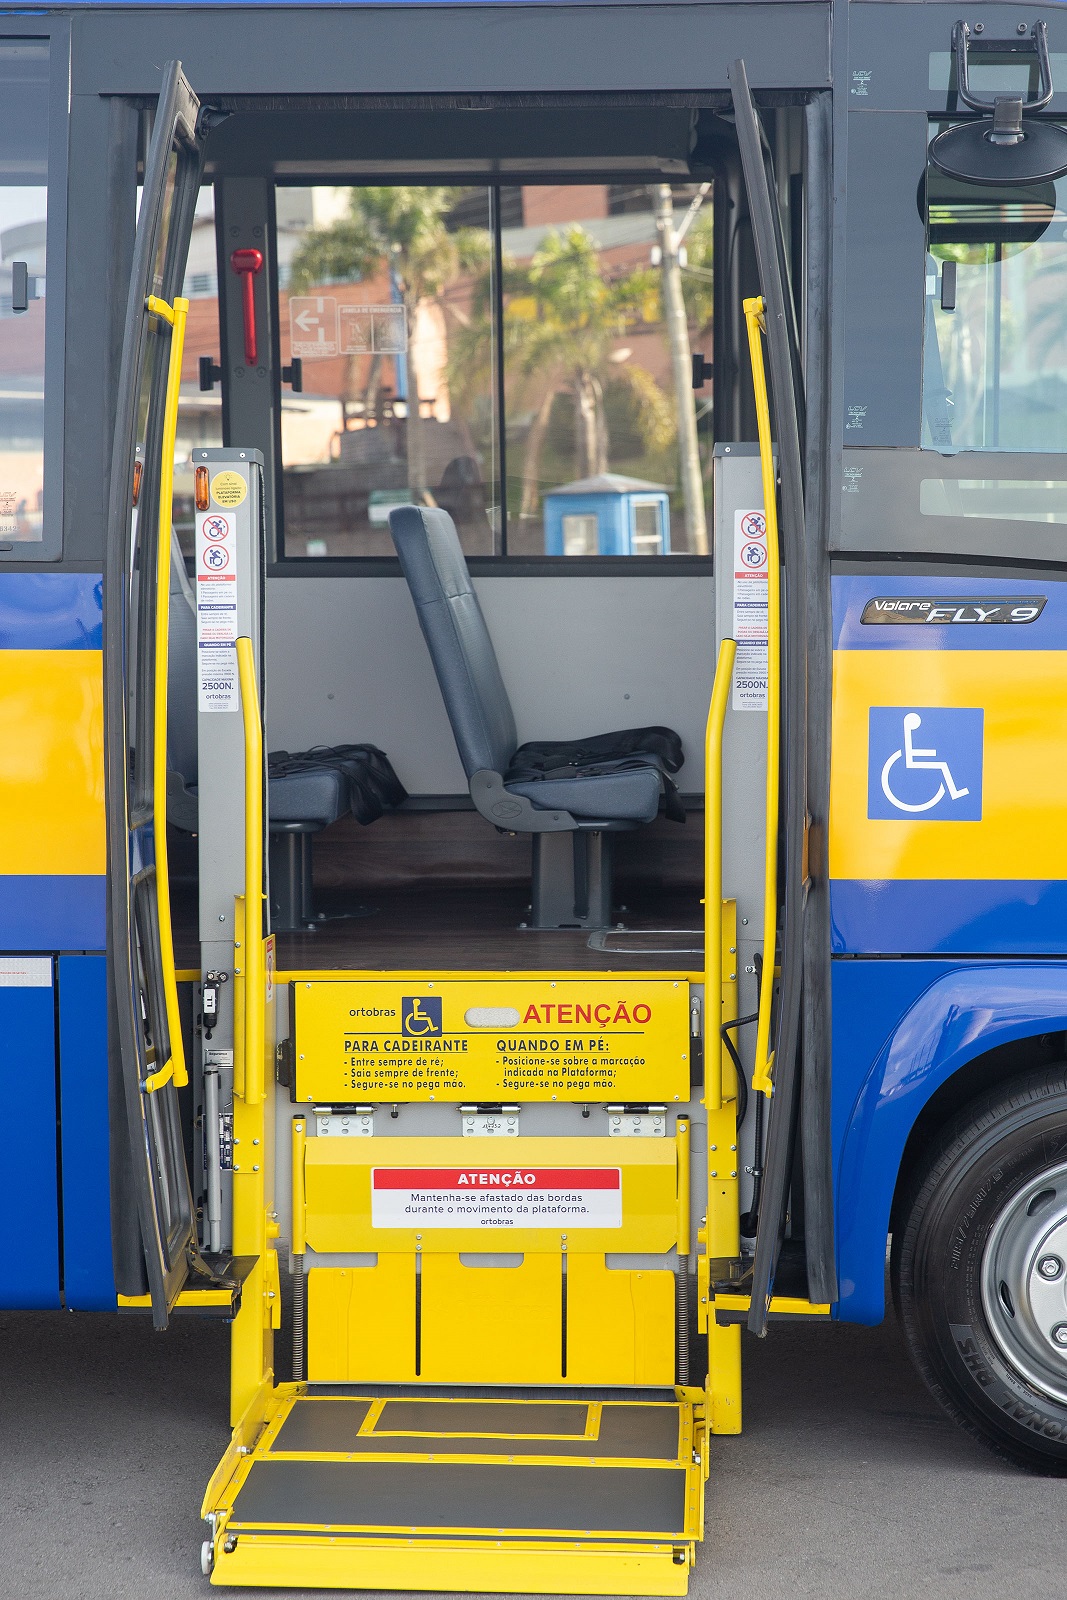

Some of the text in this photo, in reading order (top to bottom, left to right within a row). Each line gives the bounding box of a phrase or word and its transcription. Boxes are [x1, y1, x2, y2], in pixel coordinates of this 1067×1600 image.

[874, 601, 932, 611] Volare
[925, 608, 1038, 622] FLY 9
[349, 1008, 396, 1017] ortobras
[523, 1001, 652, 1028] ATENÇÃO
[344, 1040, 468, 1051] PARA CADEIRANTE
[497, 1036, 609, 1052] QUANDO EM PÉ:
[351, 1057, 374, 1066] Entre
[378, 1059, 413, 1068] sempre
[416, 1057, 427, 1066] de
[430, 1057, 444, 1067] ré;
[503, 1056, 560, 1065] Posicione-se
[563, 1056, 588, 1065] sobre
[600, 1056, 645, 1067] marcação
[351, 1069, 371, 1077] Saia
[374, 1070, 409, 1079] sempre
[412, 1068, 423, 1077] de
[427, 1068, 458, 1078] frente;
[504, 1067, 544, 1076] indicada
[562, 1067, 616, 1078] Plataforma;
[351, 1080, 398, 1090] Segure-se
[417, 1081, 440, 1090] pega
[443, 1079, 466, 1088] mão.
[503, 1079, 549, 1090] Segure-se
[567, 1080, 590, 1090] pega
[593, 1078, 616, 1087] mão.
[458, 1171, 536, 1187] ATENÇÃO
[411, 1193, 582, 1202] Mantenha-se afastado das bordas
[405, 1205, 444, 1213] durante
[457, 1205, 513, 1213] movimento
[516, 1205, 529, 1213] da
[532, 1204, 589, 1214] plataforma.
[957, 1336, 998, 1387] RHS
